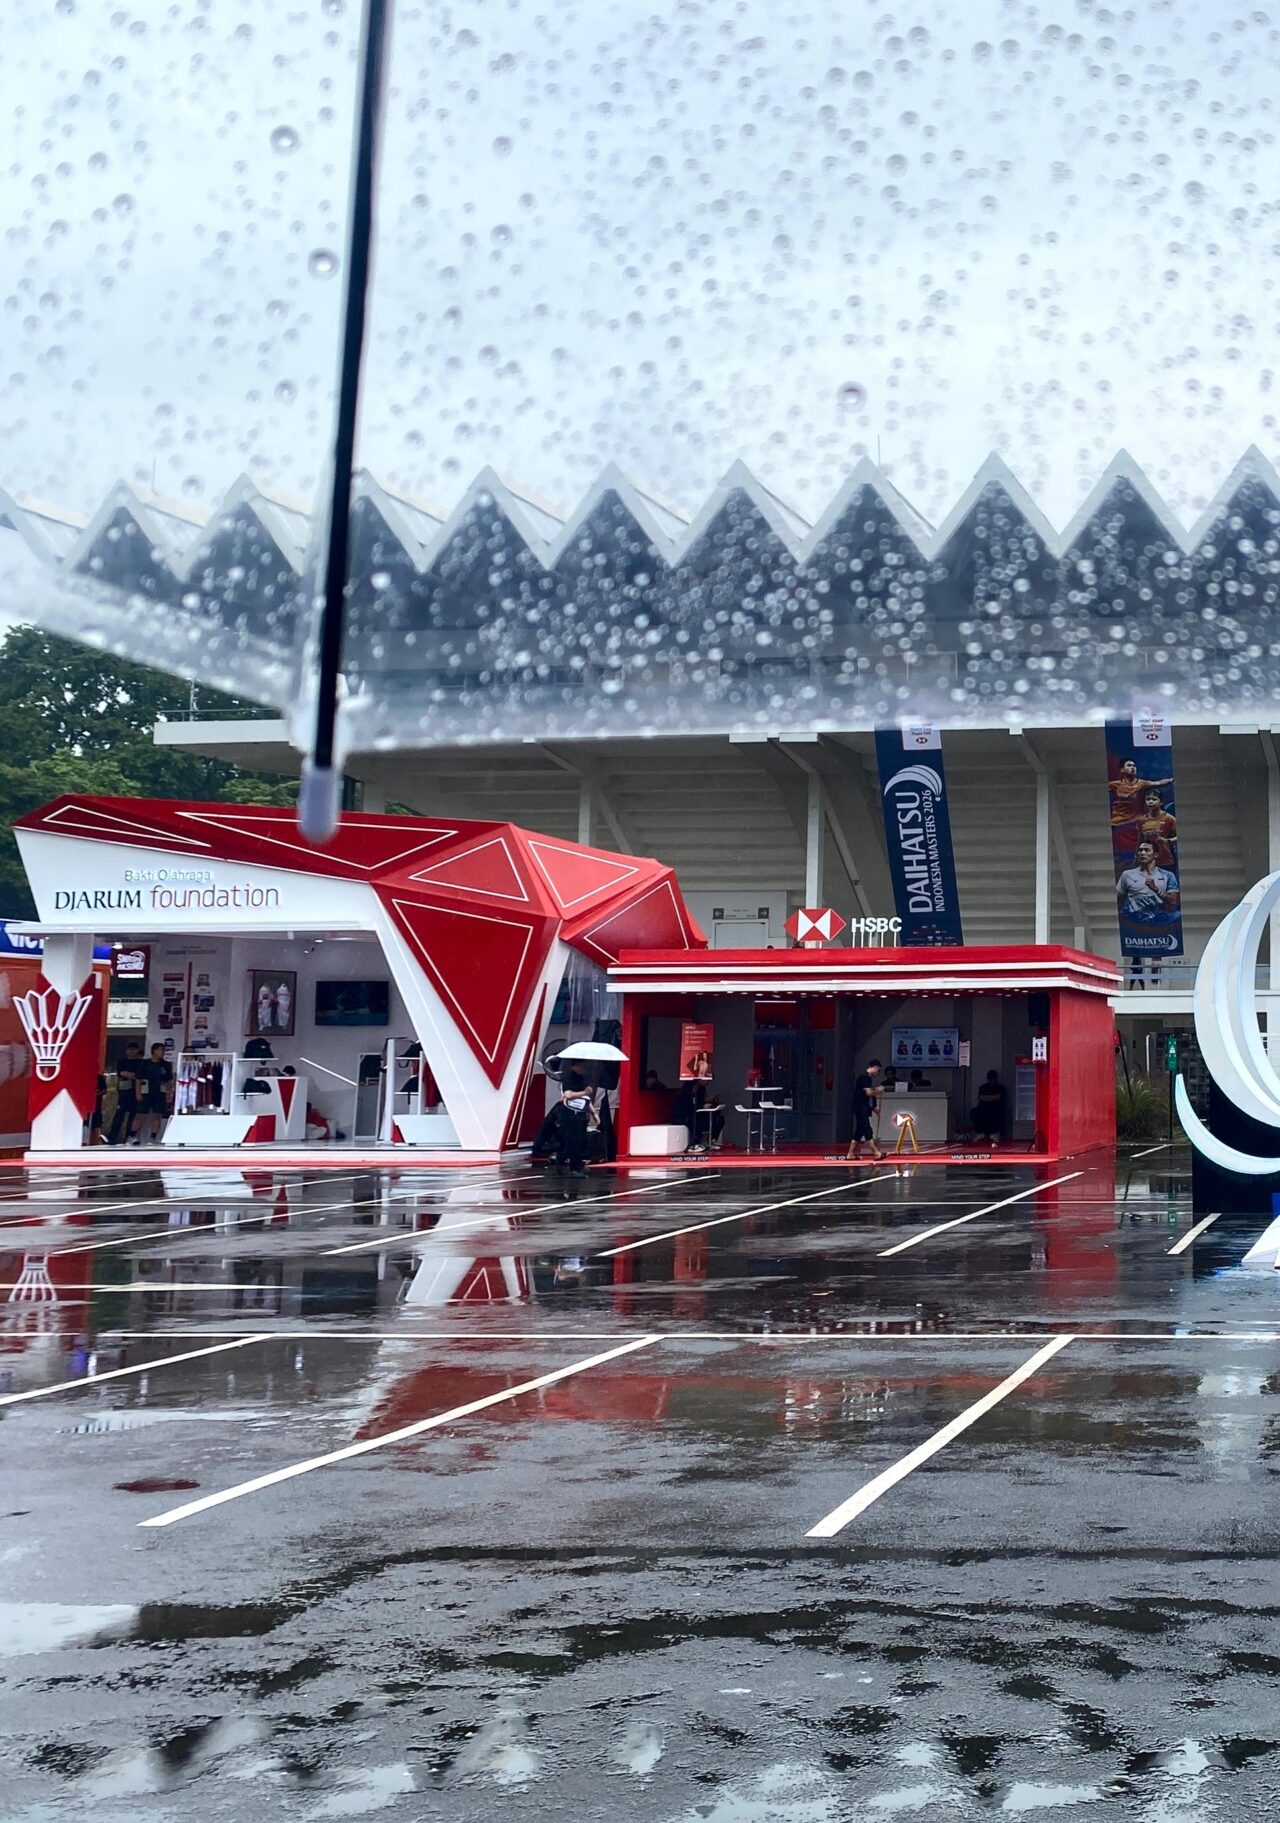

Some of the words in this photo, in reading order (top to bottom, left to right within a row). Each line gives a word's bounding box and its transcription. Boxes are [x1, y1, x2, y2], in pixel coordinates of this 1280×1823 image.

[922, 789, 934, 814] 2026
[925, 815, 940, 860] MASTERS
[895, 792, 933, 912] DAIHATSU
[124, 869, 154, 882] Bakti
[158, 869, 211, 883] Olahraga
[930, 861, 946, 912] INDONESIA
[55, 890, 141, 911] DJARUM
[149, 884, 279, 908] foundation
[851, 917, 902, 932] HSBC
[1124, 936, 1170, 946] DAIHATSU
